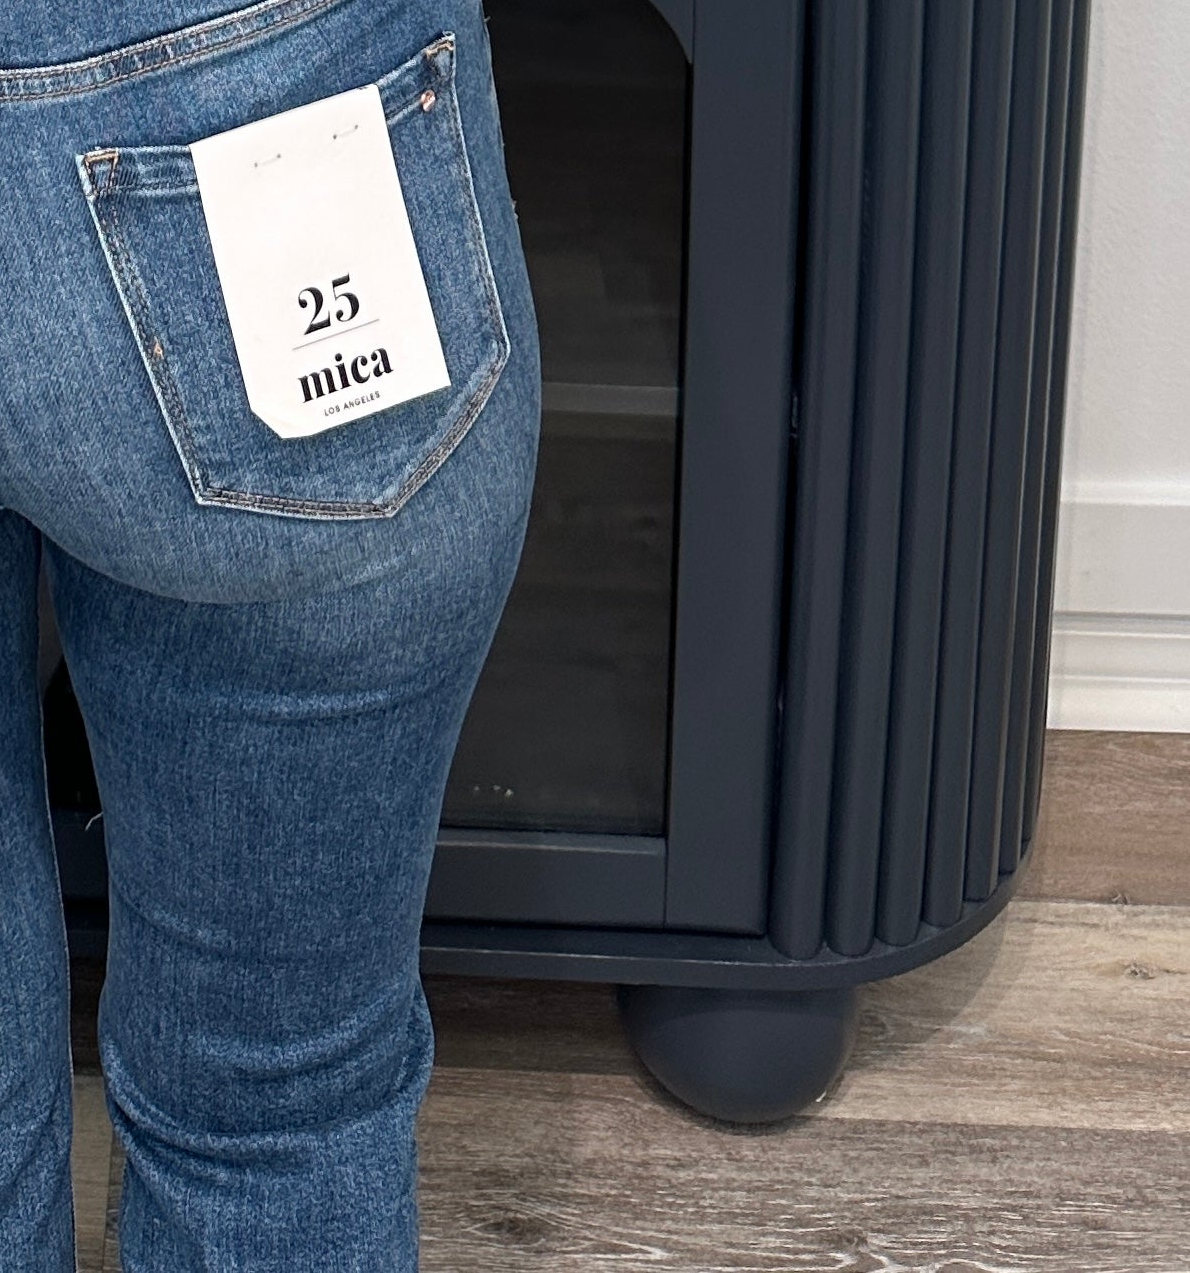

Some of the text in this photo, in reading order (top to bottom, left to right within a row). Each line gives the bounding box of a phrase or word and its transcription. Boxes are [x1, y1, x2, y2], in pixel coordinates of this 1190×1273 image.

[298, 272, 360, 336] 25
[297, 348, 394, 404] mica
[324, 390, 381, 417] LOS ANGELES
